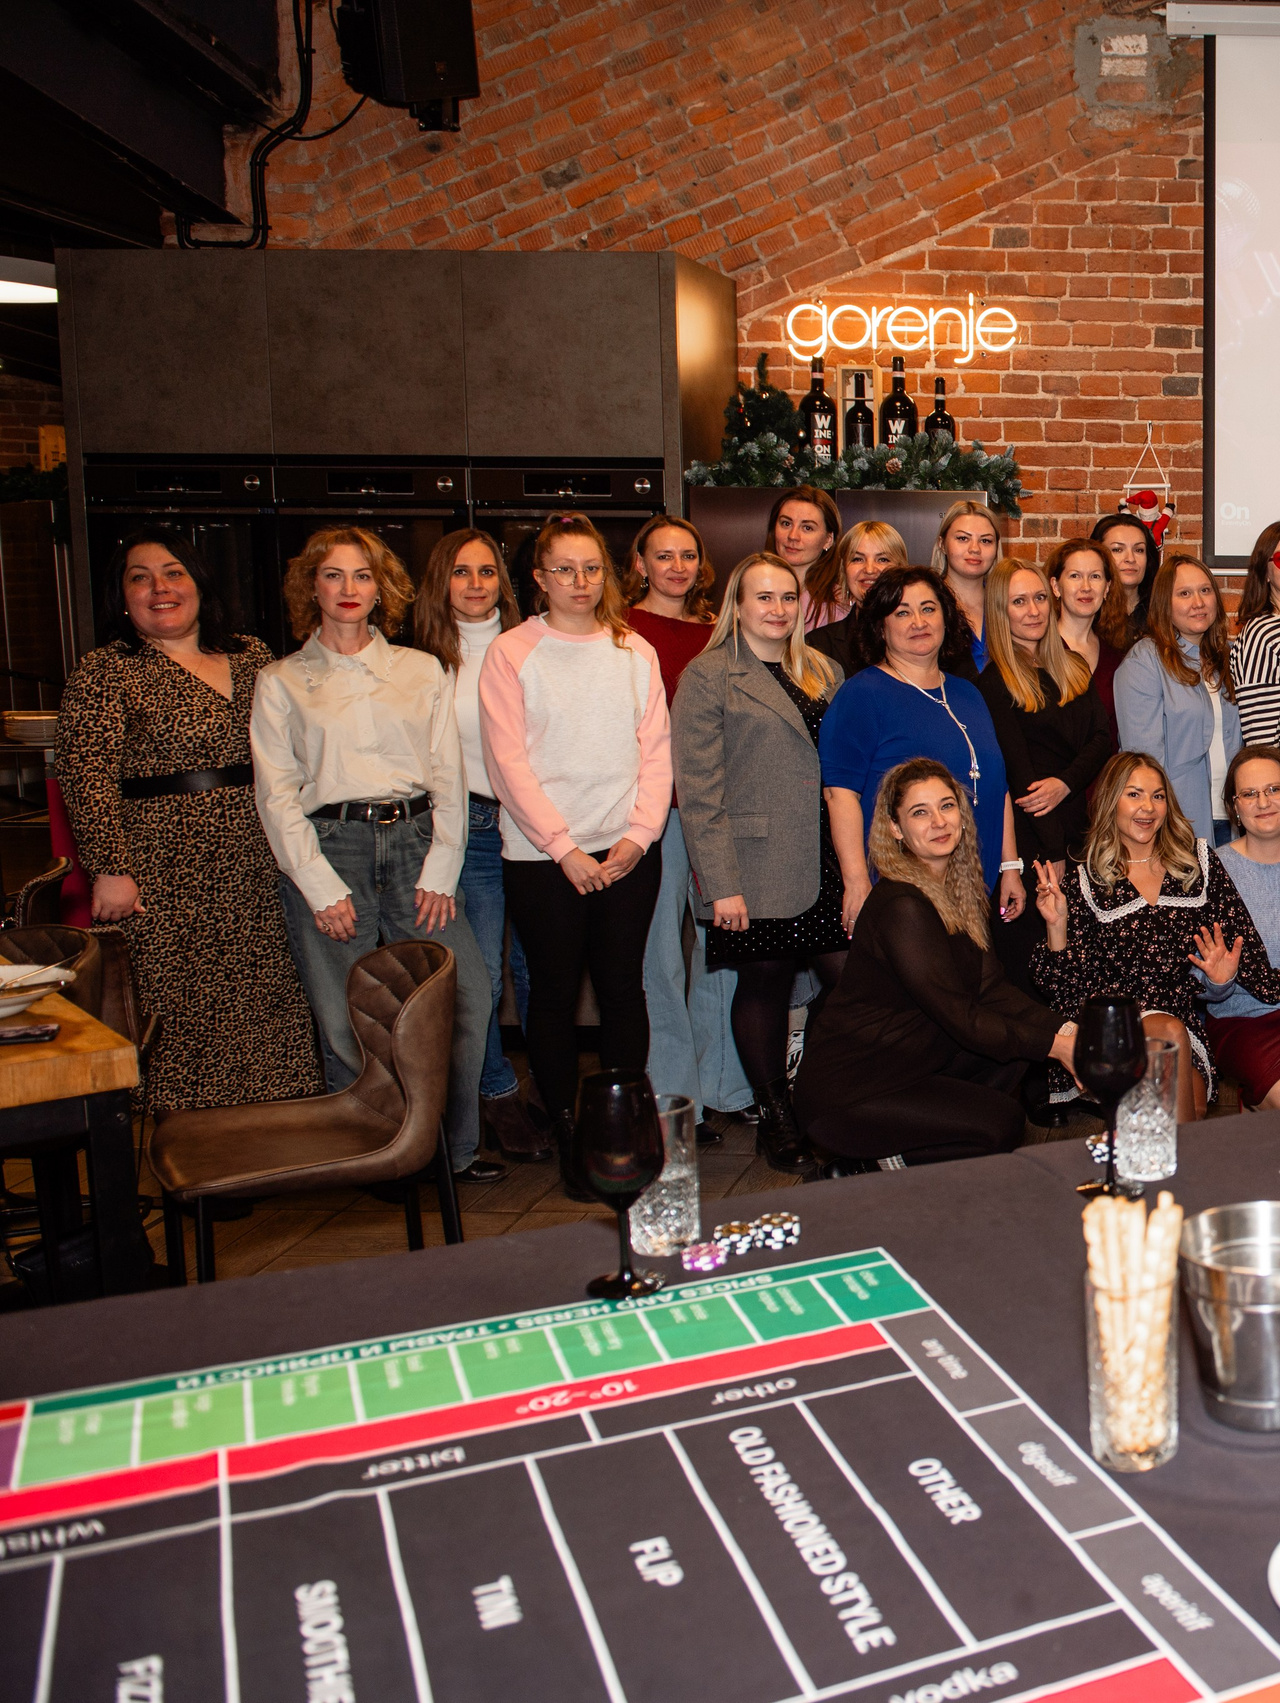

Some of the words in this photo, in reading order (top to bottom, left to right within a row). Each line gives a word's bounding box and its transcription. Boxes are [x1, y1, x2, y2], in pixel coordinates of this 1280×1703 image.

[786, 293, 1018, 364] gorenje
[814, 414, 832, 429] W
[814, 429, 832, 439] INE
[888, 419, 906, 434] W
[814, 444, 831, 454] ON
[1220, 502, 1250, 520] On
[616, 1288, 675, 1311] AND
[682, 1274, 774, 1296] SPICES
[515, 1301, 612, 1328] HERBS
[359, 1344, 384, 1357] И
[388, 1323, 497, 1353] ТРАВЫ
[176, 1350, 354, 1390] ПРЯНОСТИ
[921, 1338, 949, 1358] any
[937, 1353, 968, 1380] time
[710, 1377, 797, 1405] other
[361, 1445, 466, 1480] bitter
[728, 1425, 775, 1466] OLD
[1018, 1441, 1078, 1487] digestif
[908, 1457, 982, 1525] OTHER
[749, 1461, 848, 1576] FASHIONED
[628, 1535, 685, 1587] FLIP
[471, 1574, 524, 1631] TINI
[820, 1571, 897, 1655] STYLE
[1141, 1572, 1215, 1633] aperitif
[116, 1654, 164, 1703] FIZ
[889, 1660, 1020, 1703] vodka
